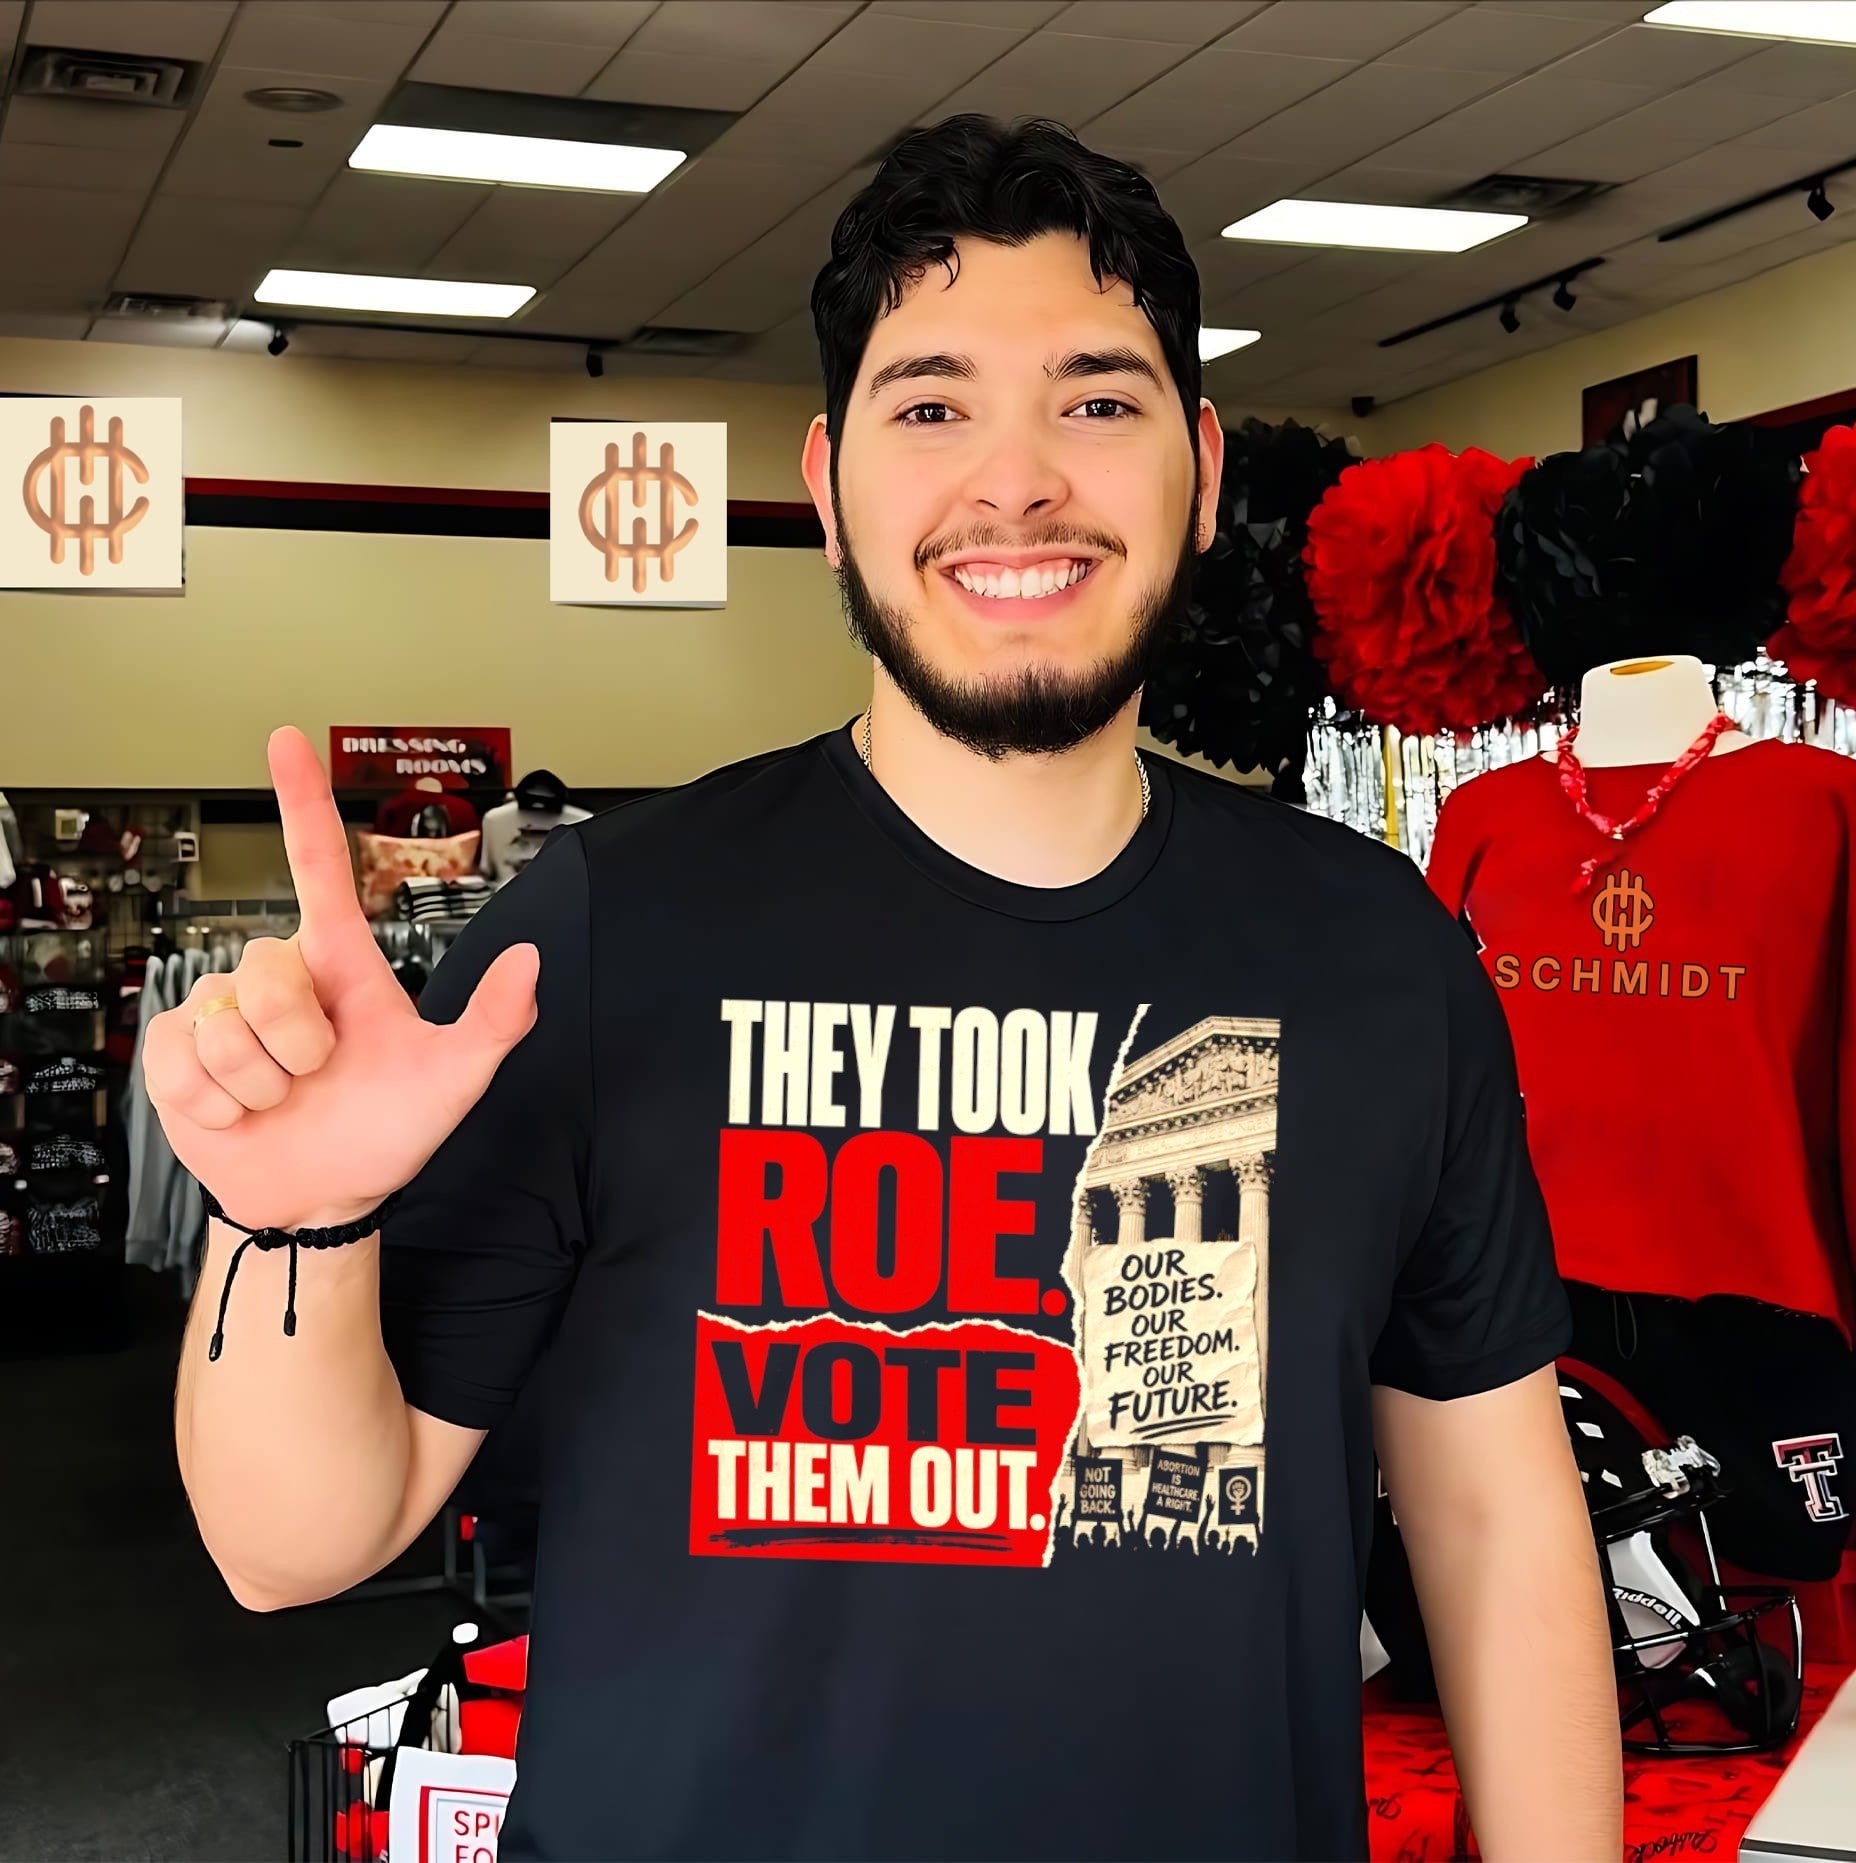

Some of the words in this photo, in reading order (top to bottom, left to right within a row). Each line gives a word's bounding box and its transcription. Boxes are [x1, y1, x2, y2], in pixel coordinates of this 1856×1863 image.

[396, 758, 487, 775] ROOMS
[1494, 954, 1747, 1000] SCHMIDT
[721, 999, 897, 1128] THEY
[909, 1006, 1098, 1136] TOOK
[715, 1128, 1067, 1316] ROE.
[1121, 1250, 1188, 1282] OUR
[1103, 1273, 1223, 1316] BODIES.
[1131, 1309, 1188, 1337] OUR
[1104, 1328, 1240, 1373] FREEDOM.
[1142, 1361, 1195, 1387] OUR
[711, 1341, 1037, 1446] VOTE
[1108, 1380, 1238, 1431] FUTURE.
[1084, 1467, 1112, 1483] NOT
[1157, 1459, 1200, 1477] ABORTION
[1171, 1474, 1182, 1485] IS
[708, 1439, 890, 1524] THEM
[909, 1446, 1046, 1531] OUT.
[1080, 1484, 1116, 1499] GOING
[1080, 1500, 1116, 1515] BACK.
[1156, 1495, 1164, 1506] A
[1165, 1497, 1192, 1512] RIGHT.
